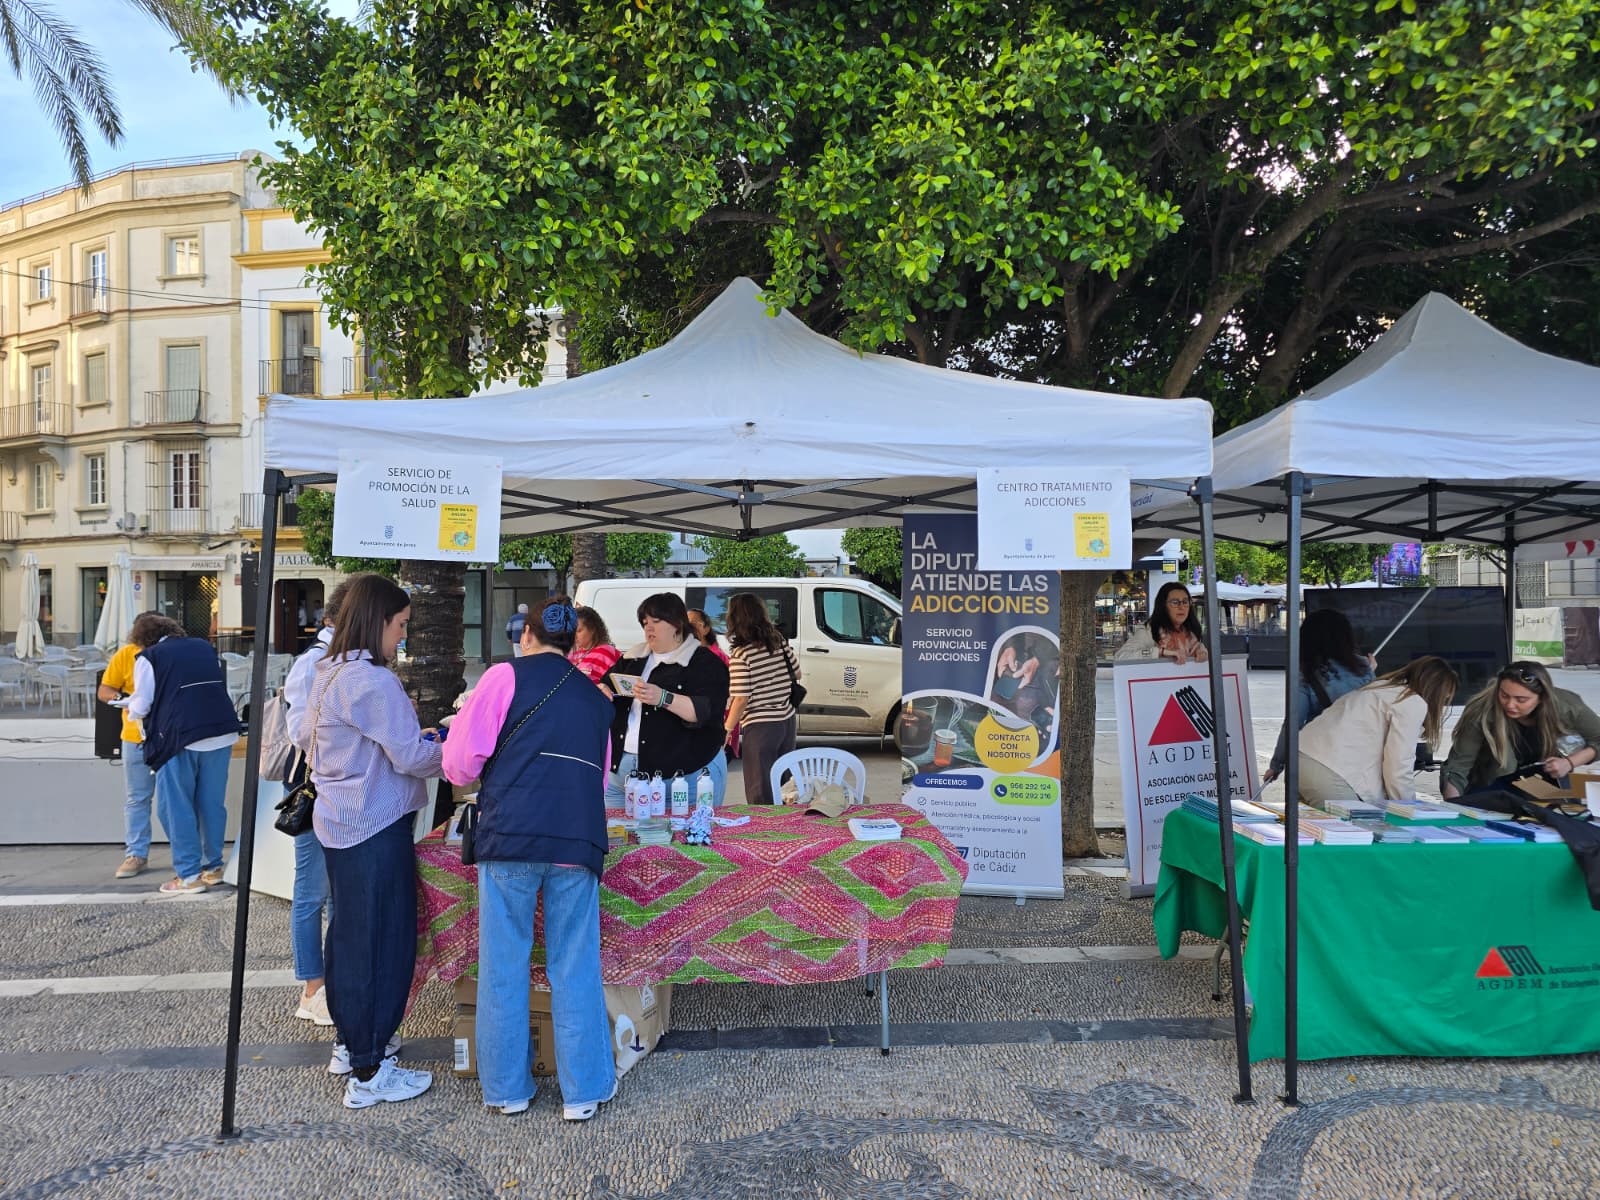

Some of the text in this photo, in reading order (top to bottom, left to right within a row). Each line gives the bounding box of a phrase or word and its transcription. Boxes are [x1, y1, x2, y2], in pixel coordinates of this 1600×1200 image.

[388, 467, 452, 480] SERVICIO DE
[368, 480, 470, 495] PROMOCIÓN DE LA
[997, 482, 1113, 492] CENTRO TRATAMIENTO
[401, 497, 437, 509] SALUD
[1024, 497, 1087, 507] ADICCIONES
[911, 532, 937, 550] LA
[910, 574, 1049, 592] ATIENDE LAS
[910, 595, 1050, 614] ADICCIONES
[926, 628, 973, 638] SERVICIO
[912, 640, 987, 650] PROVINCIAL DE
[918, 652, 980, 662] ADICCIONES
[987, 733, 1030, 742] CONTACTA
[987, 751, 1031, 760] NOSOTROS
[925, 778, 968, 786] OFRECEMOS
[1147, 773, 1196, 789] ASOCIACIÓN
[1144, 796, 1155, 807] DE
[973, 847, 1026, 860] Diputación
[973, 861, 1017, 873] de Cádiz
[1477, 979, 1543, 990] AGDEM
